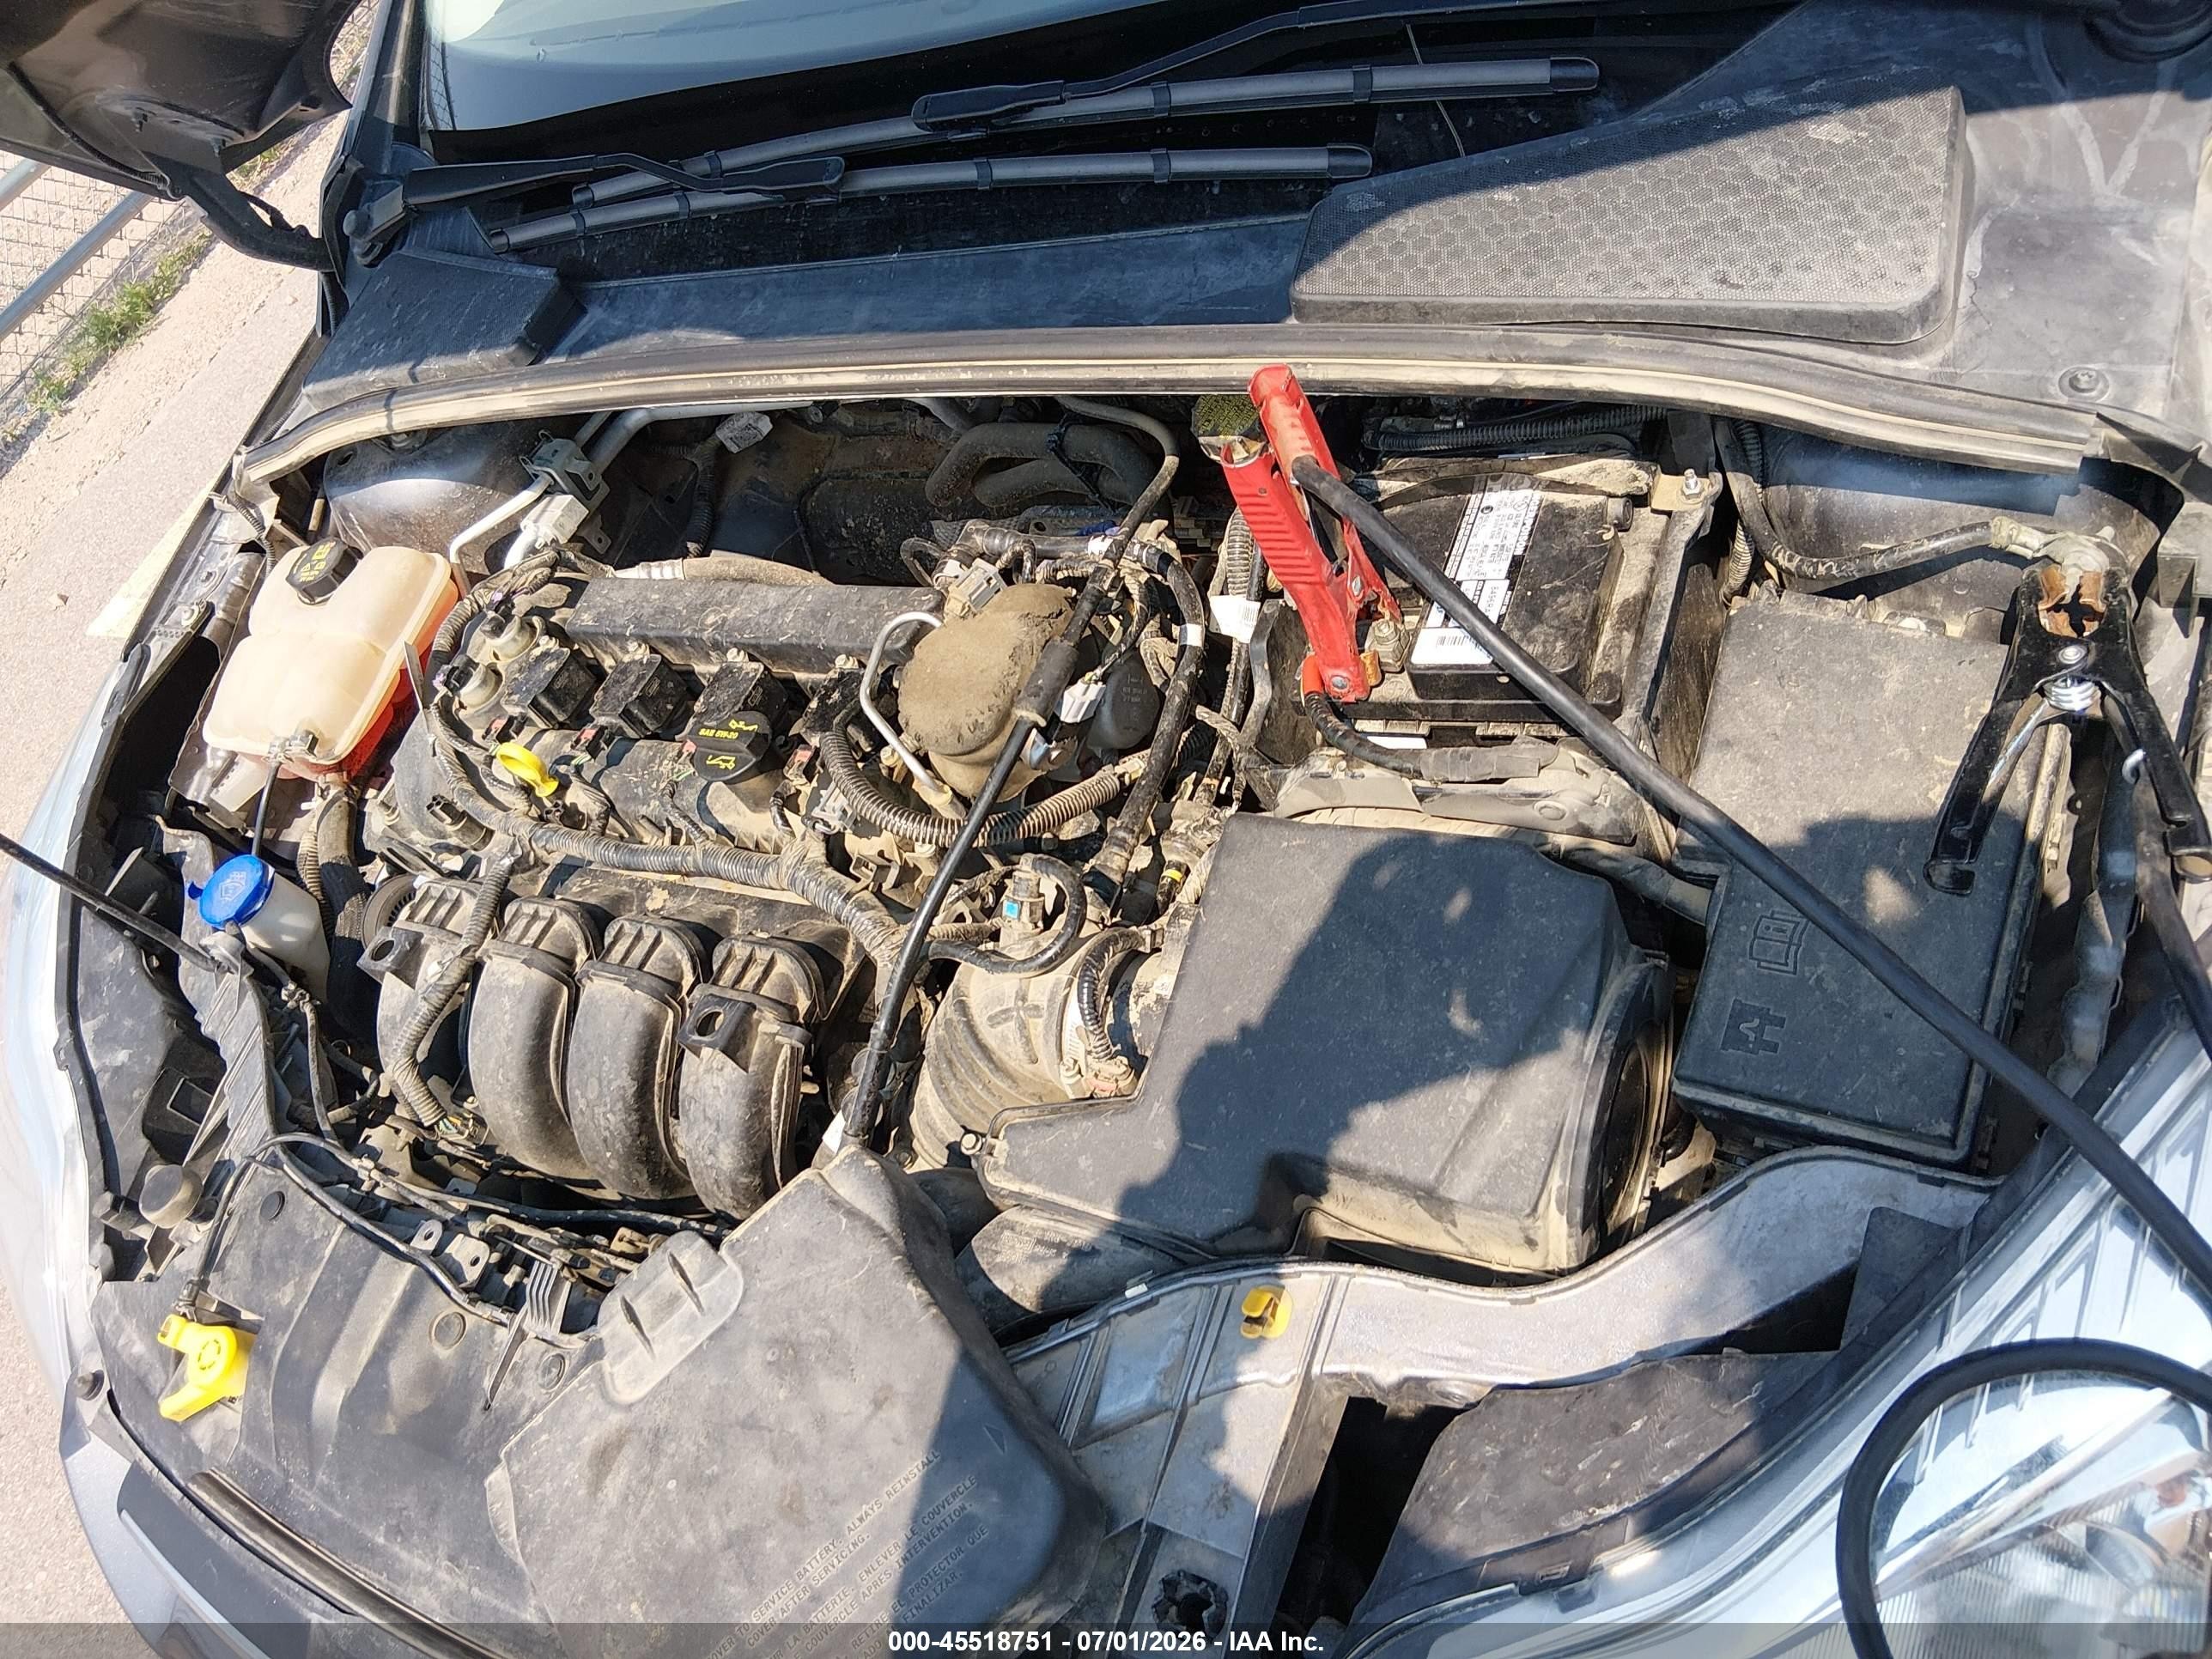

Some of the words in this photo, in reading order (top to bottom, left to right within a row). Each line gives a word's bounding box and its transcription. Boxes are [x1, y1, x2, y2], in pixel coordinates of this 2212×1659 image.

[711, 1637, 734, 1659] OVER
[737, 1621, 750, 1637] TO
[752, 1579, 793, 1622] SERVICE
[795, 1535, 842, 1580] BATTERY.
[845, 1498, 883, 1534] ALWAYS
[885, 1449, 939, 1499] REINSTALL
[746, 1616, 776, 1648] COVER
[778, 1584, 809, 1617] AFTER
[811, 1529, 869, 1585] SERVICING.
[786, 1634, 799, 1650] LA
[802, 1583, 853, 1634] BATTERIE.
[858, 1540, 901, 1582] ENLEVER
[903, 1525, 918, 1540] LE
[921, 1474, 975, 1526] COUVERCLE
[805, 1599, 859, 1652] COUVERCLE
[859, 1568, 891, 1601] APRES
[895, 1498, 972, 1569] INTERVENTION.
[851, 1613, 888, 1650] RETIRE
[890, 1596, 905, 1613] EL
[908, 1546, 963, 1598] PROTECTOR
[967, 1525, 987, 1546] QUE
[902, 1568, 962, 1623] FINALIZAR.
